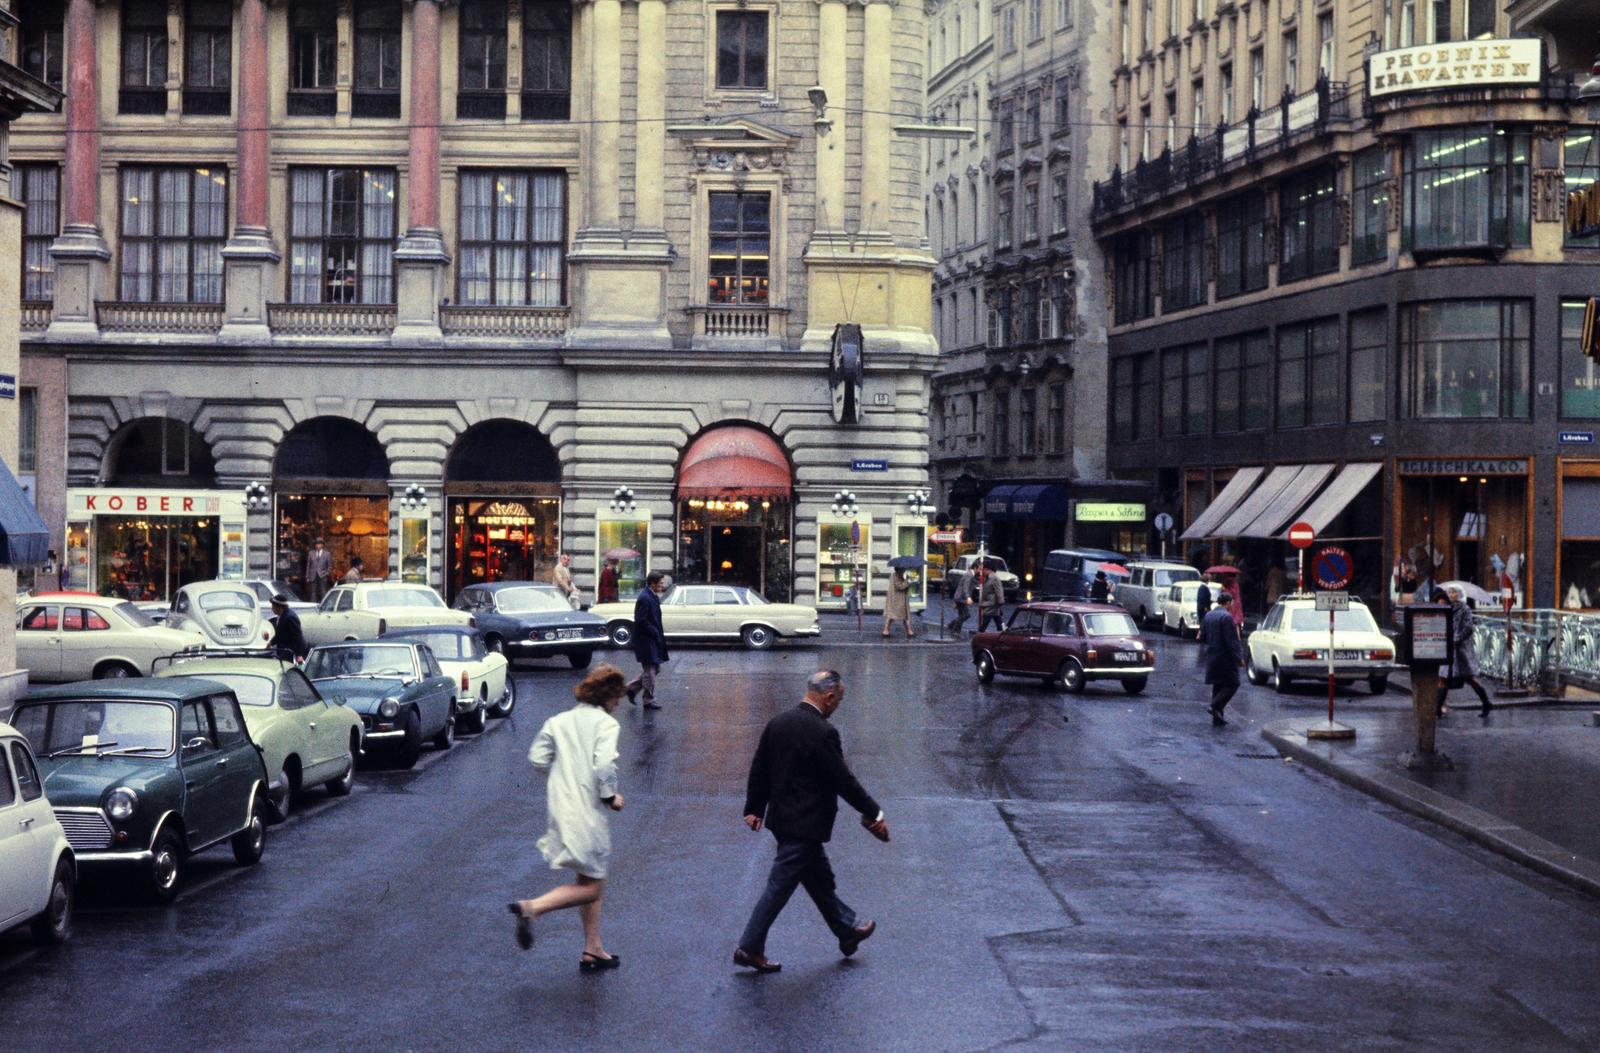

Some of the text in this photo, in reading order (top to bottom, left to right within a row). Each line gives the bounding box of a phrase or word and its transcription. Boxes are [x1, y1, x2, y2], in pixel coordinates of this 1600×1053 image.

[1386, 45, 1511, 70] PHOENIX
[1375, 63, 1530, 89] KRAWATTEN
[86, 495, 193, 512] KOBER
[478, 516, 535, 526] BOUTIQUE
[1327, 597, 1347, 605] TAXI
